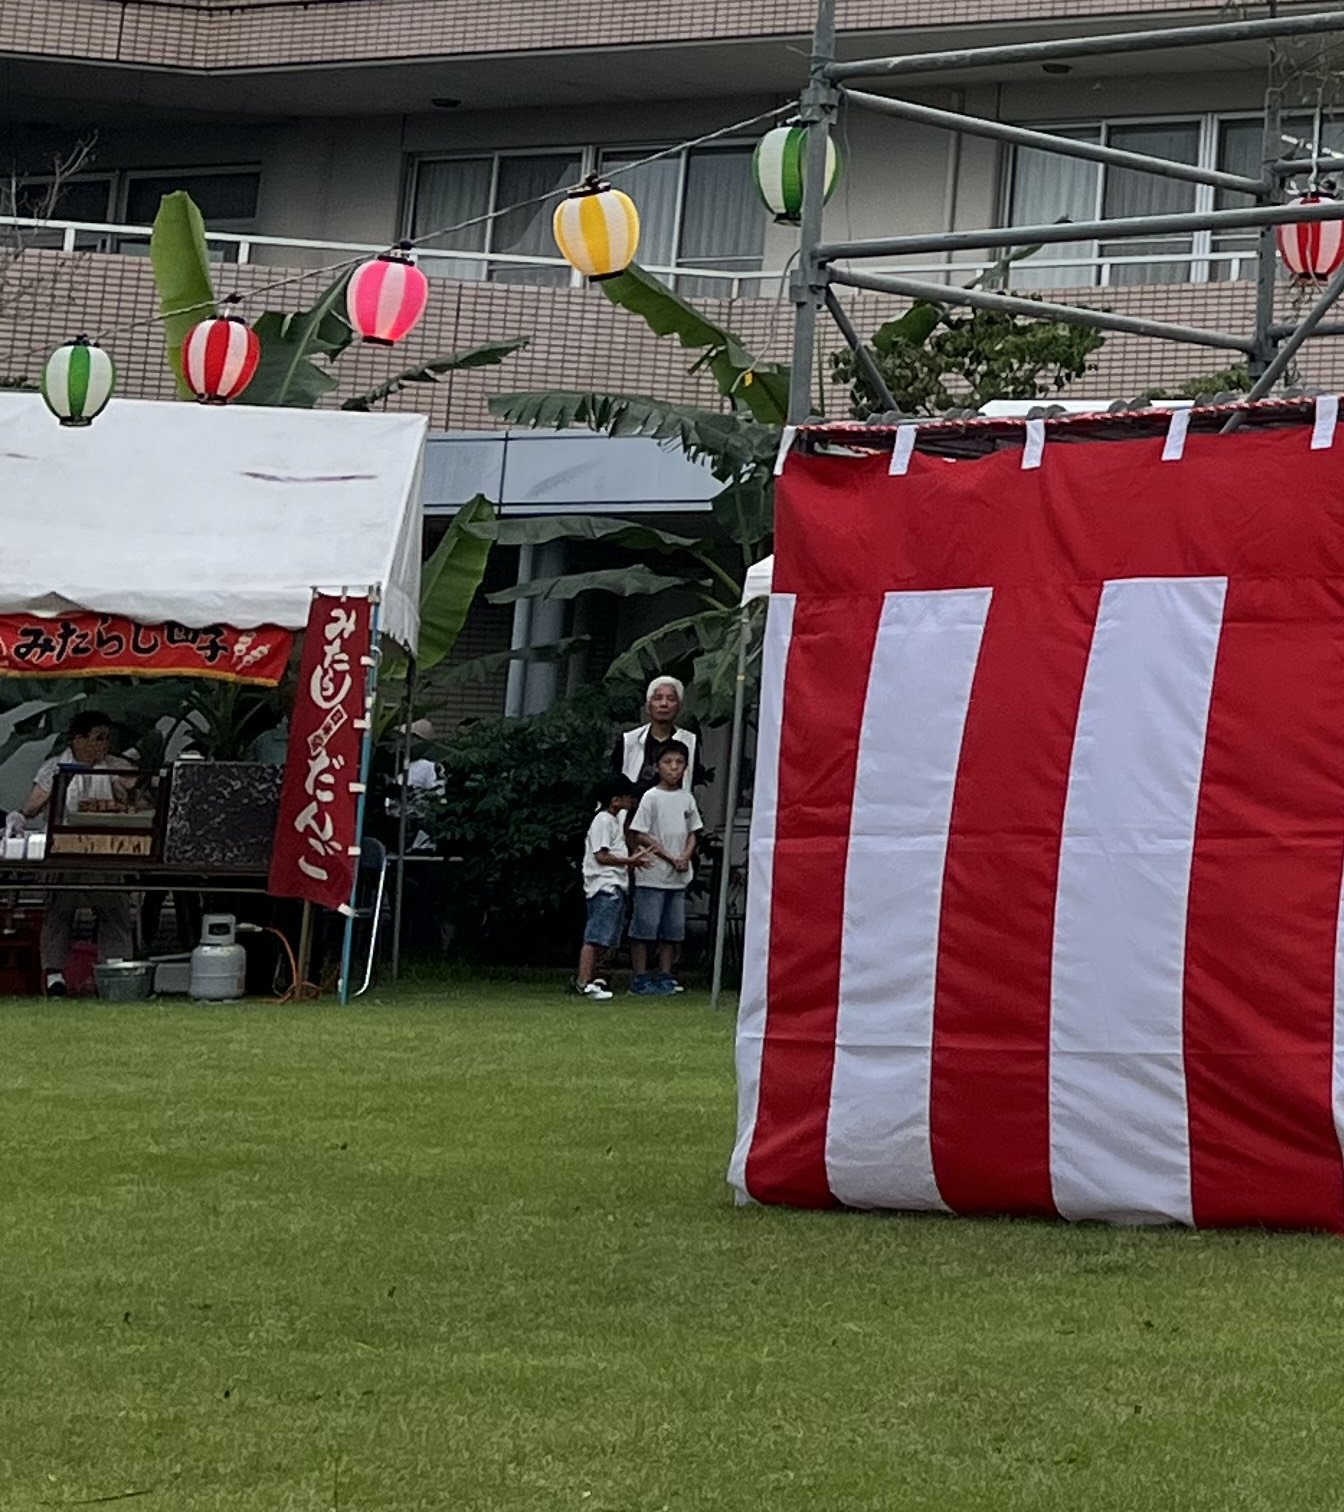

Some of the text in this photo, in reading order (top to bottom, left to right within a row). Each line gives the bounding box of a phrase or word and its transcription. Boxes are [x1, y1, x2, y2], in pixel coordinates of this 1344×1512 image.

[309, 607, 357, 710] みたらし
[294, 747, 346, 881] だんご
